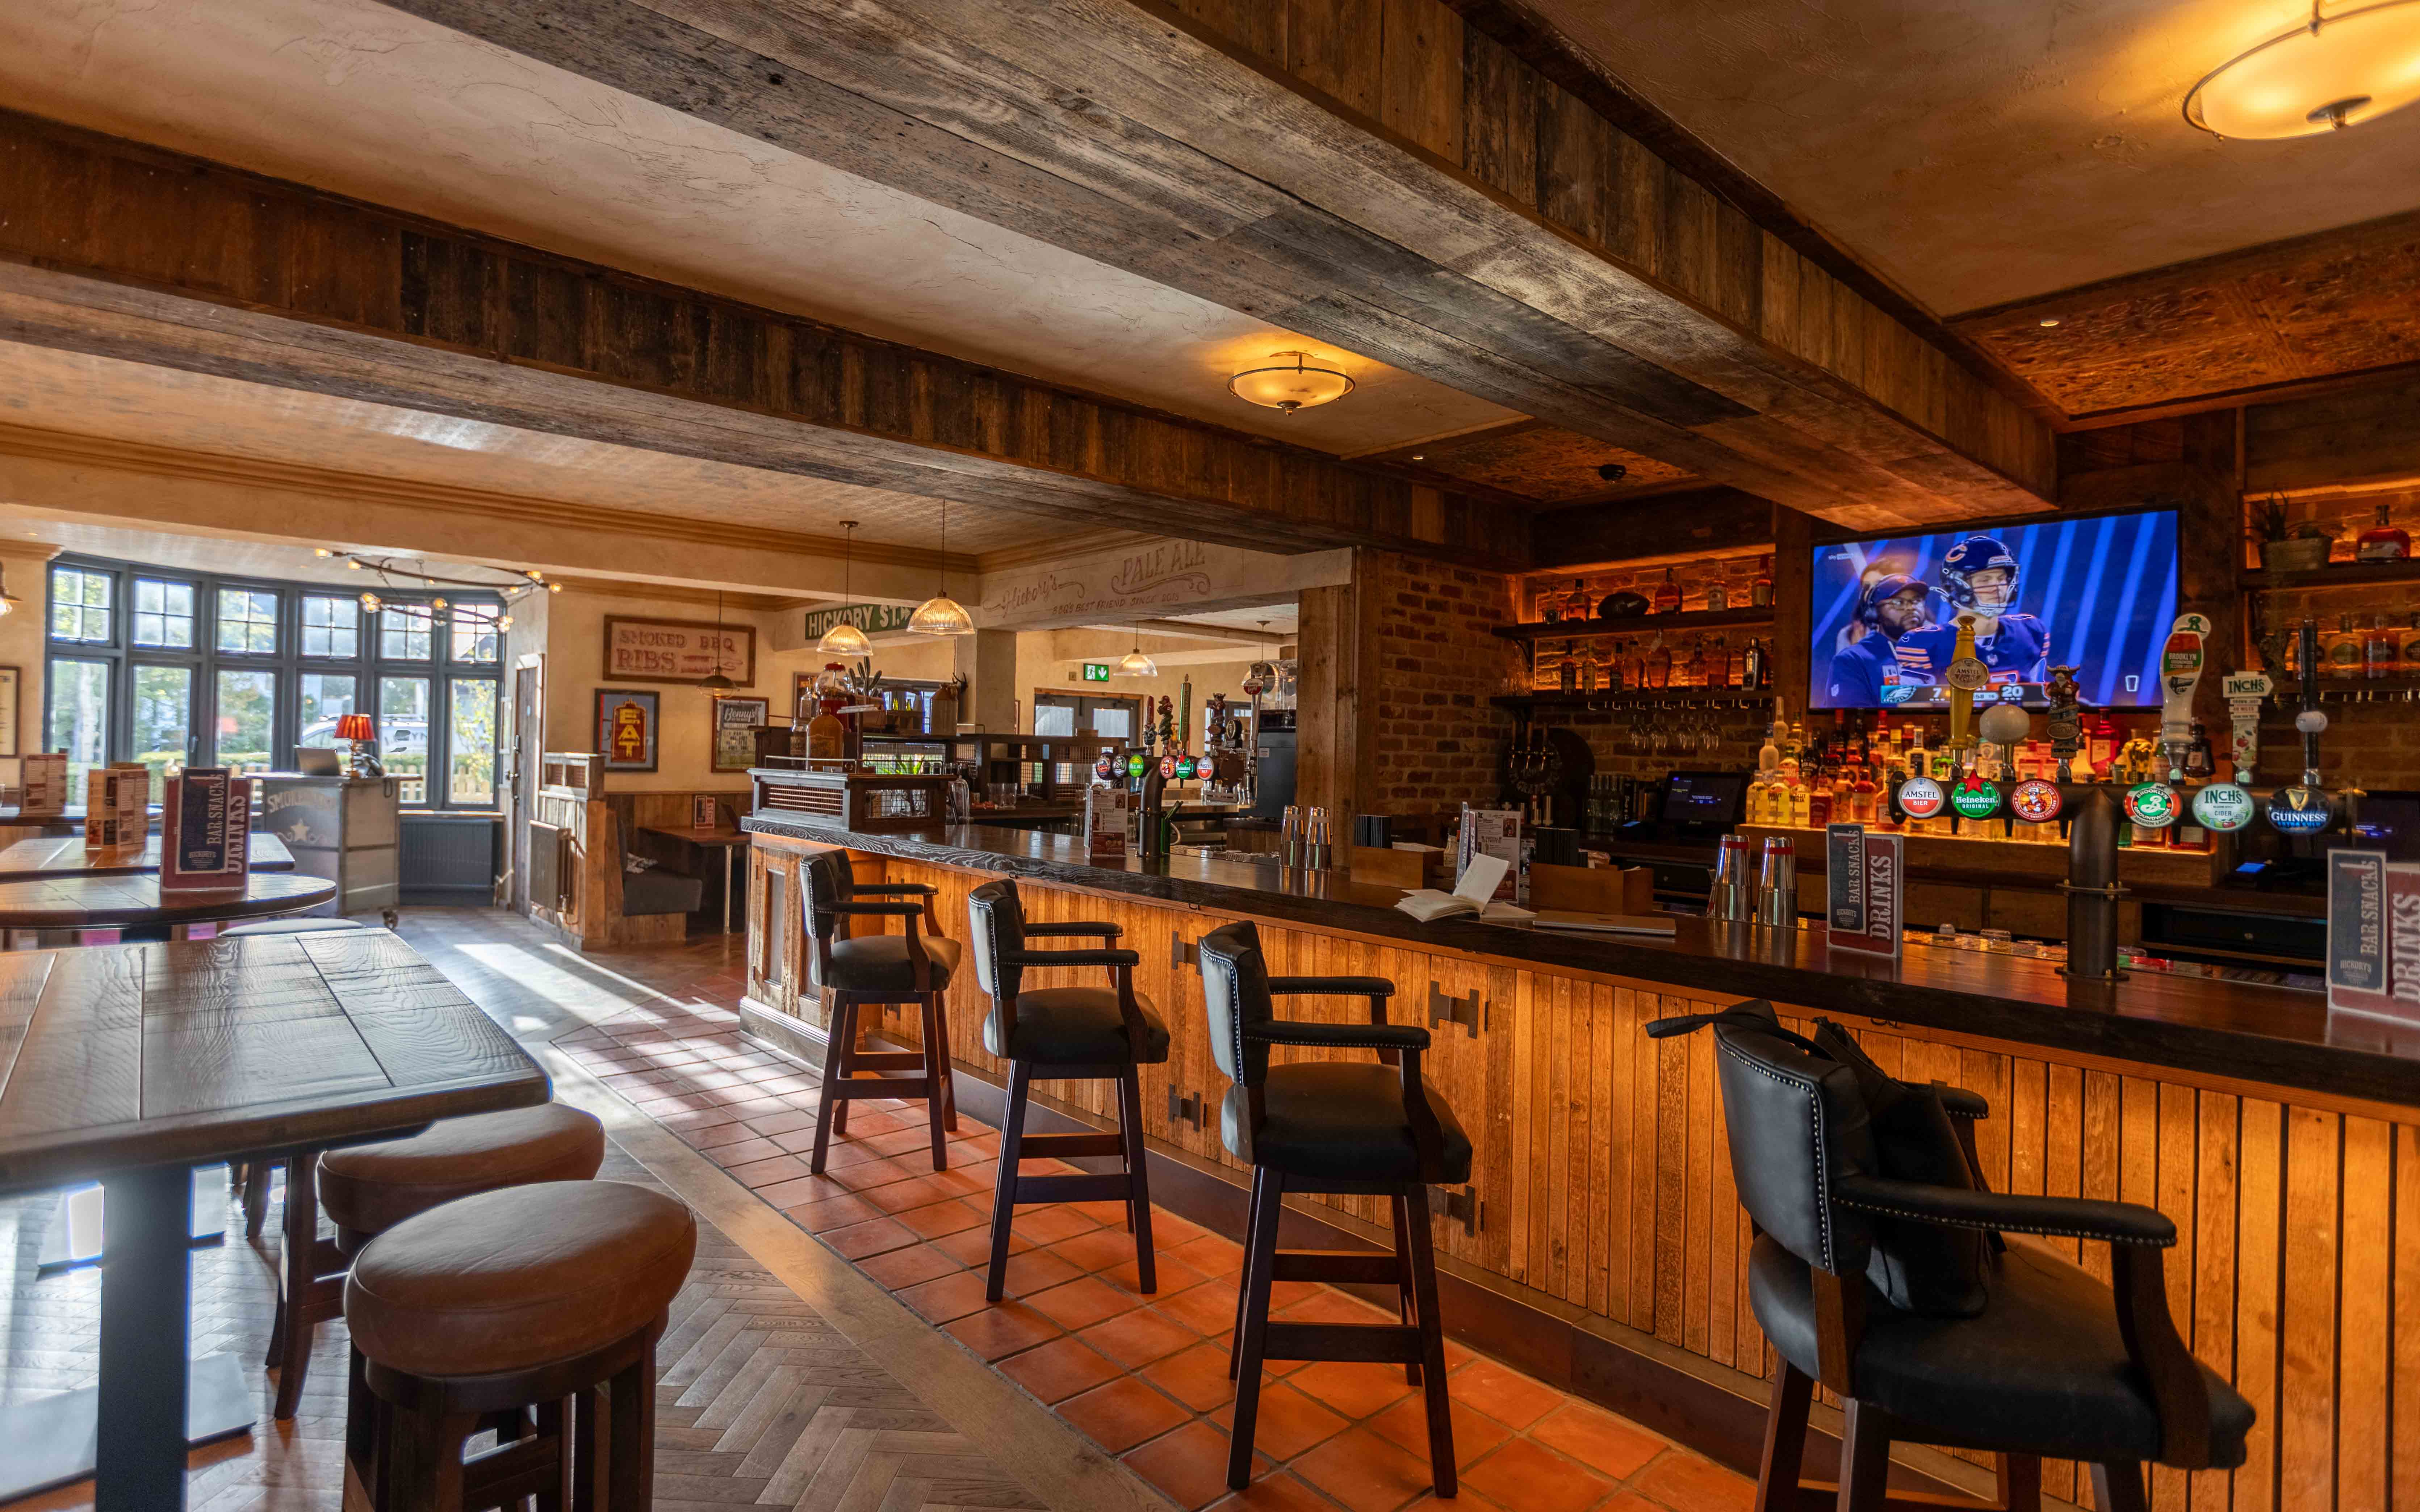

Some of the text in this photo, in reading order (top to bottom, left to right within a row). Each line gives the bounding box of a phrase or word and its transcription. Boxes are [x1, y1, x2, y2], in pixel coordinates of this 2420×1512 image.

[1122, 541, 1206, 586] PALE ALE
[999, 574, 1058, 618] Hickory's
[1052, 602, 1073, 615] BBQ'S
[1075, 601, 1096, 613] BEST
[1097, 598, 1126, 610] FRIEND
[1130, 595, 1156, 606] SINCE
[808, 605, 901, 637] HICKORY ST.
[619, 630, 736, 652] SMOKED BBQ
[616, 648, 676, 673] RIBS
[1933, 688, 1941, 698] 7
[2001, 685, 2024, 697] 20
[2228, 678, 2264, 694] INCH'S
[618, 708, 641, 758] EAT
[2136, 789, 2169, 799] BROOKLYN
[2204, 789, 2243, 804] INCH'S
[206, 774, 225, 845] BAR SNACKS
[2134, 806, 2171, 820] GROUNDWORK
[2271, 811, 2328, 822] GUINNESS
[1848, 830, 1861, 904] BAR SNACKS
[1869, 855, 1892, 940] DRINKS
[2360, 860, 2378, 956] BAR SNACKS
[1836, 908, 1857, 918] HICKORY'S
[2392, 892, 2420, 1004] DRINKS
[2340, 959, 2372, 974] HICKORY'S
